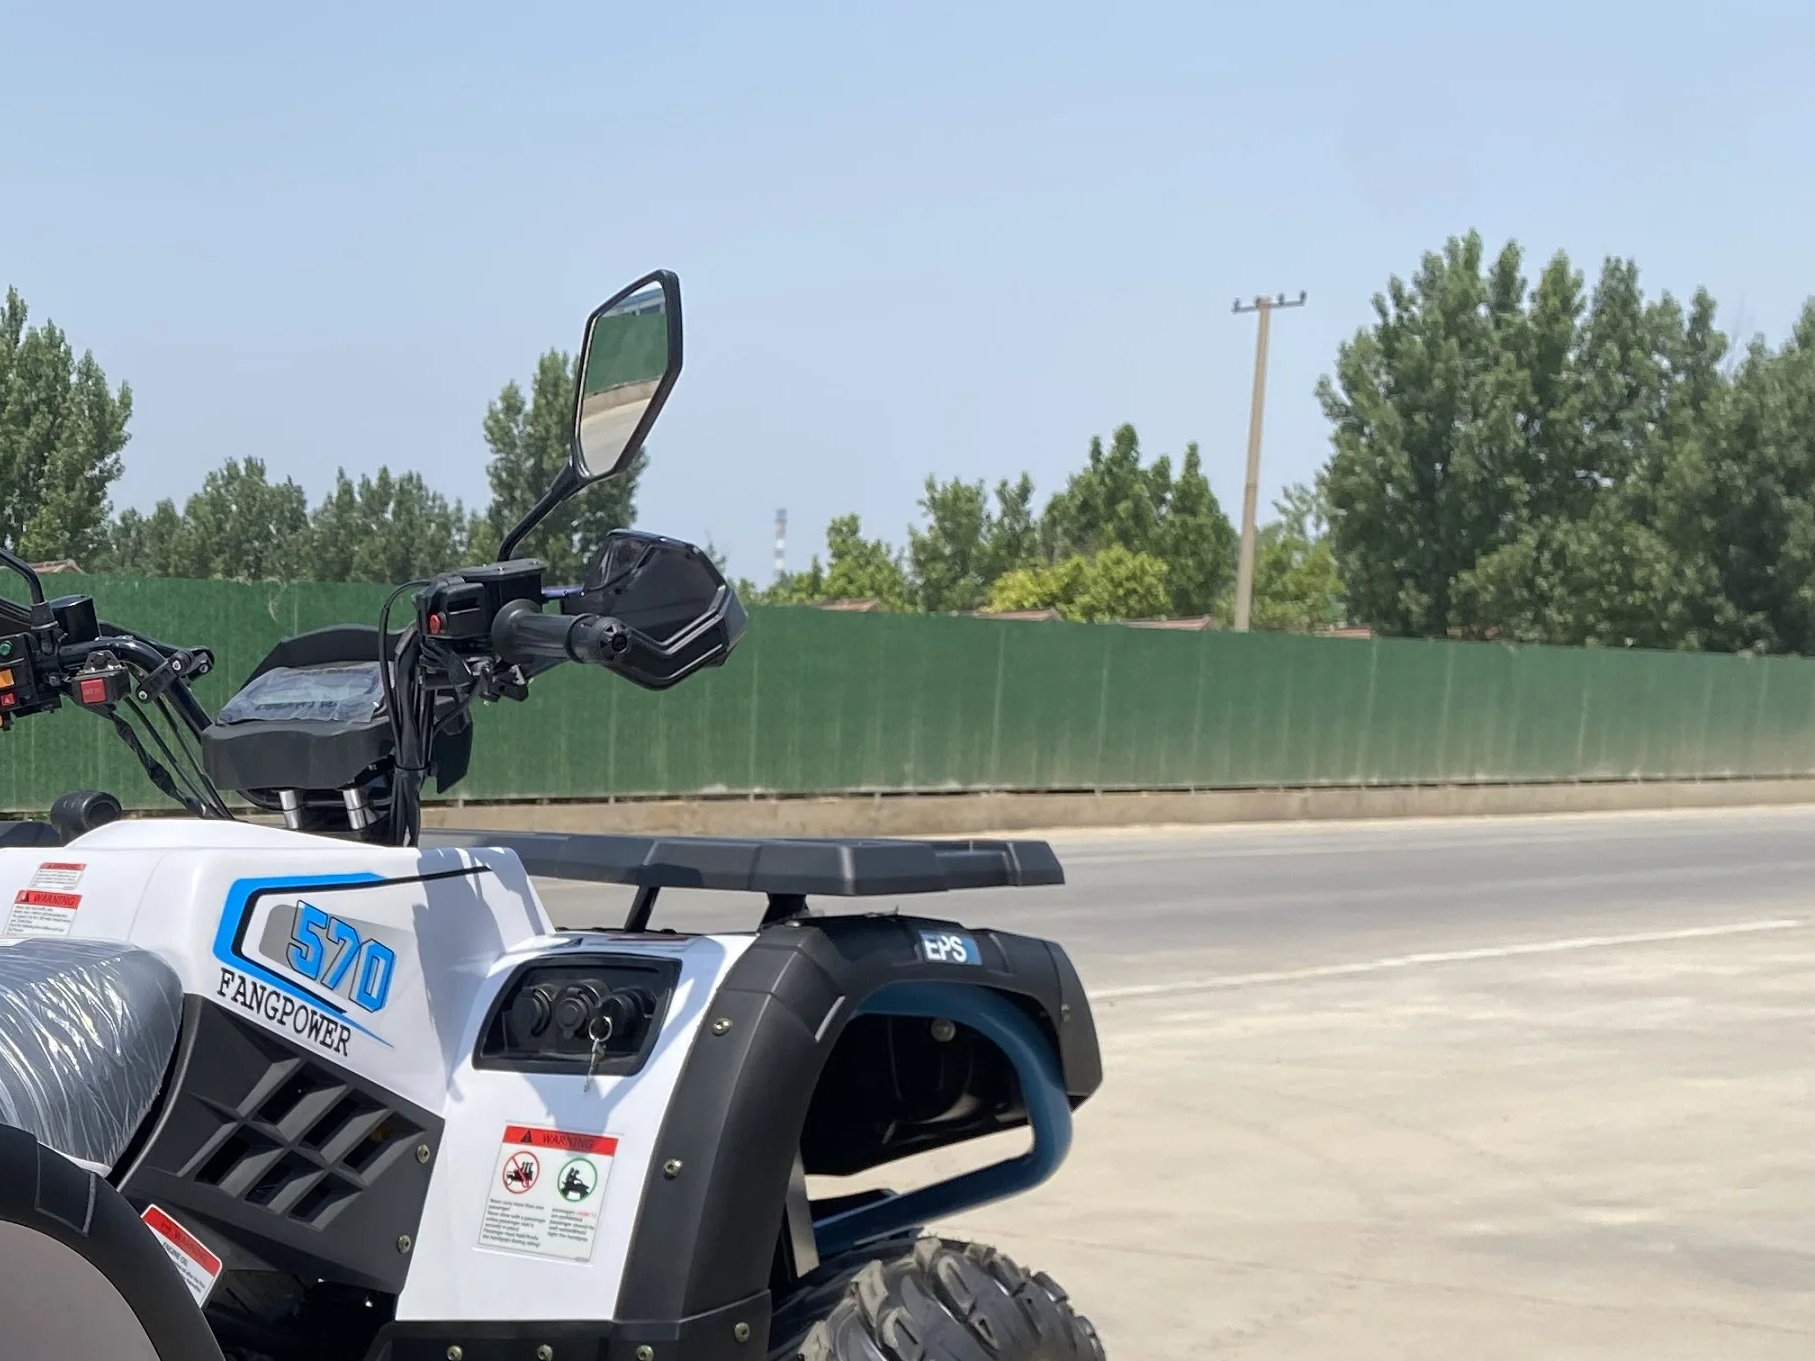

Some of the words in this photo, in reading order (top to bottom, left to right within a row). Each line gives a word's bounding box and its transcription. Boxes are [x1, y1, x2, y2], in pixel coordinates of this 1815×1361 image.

[32, 893, 76, 906] WARNING
[286, 899, 396, 1014] 570
[924, 934, 967, 963] EPS
[216, 967, 351, 1057] FANGPOWER
[542, 1132, 595, 1150] WARNING
